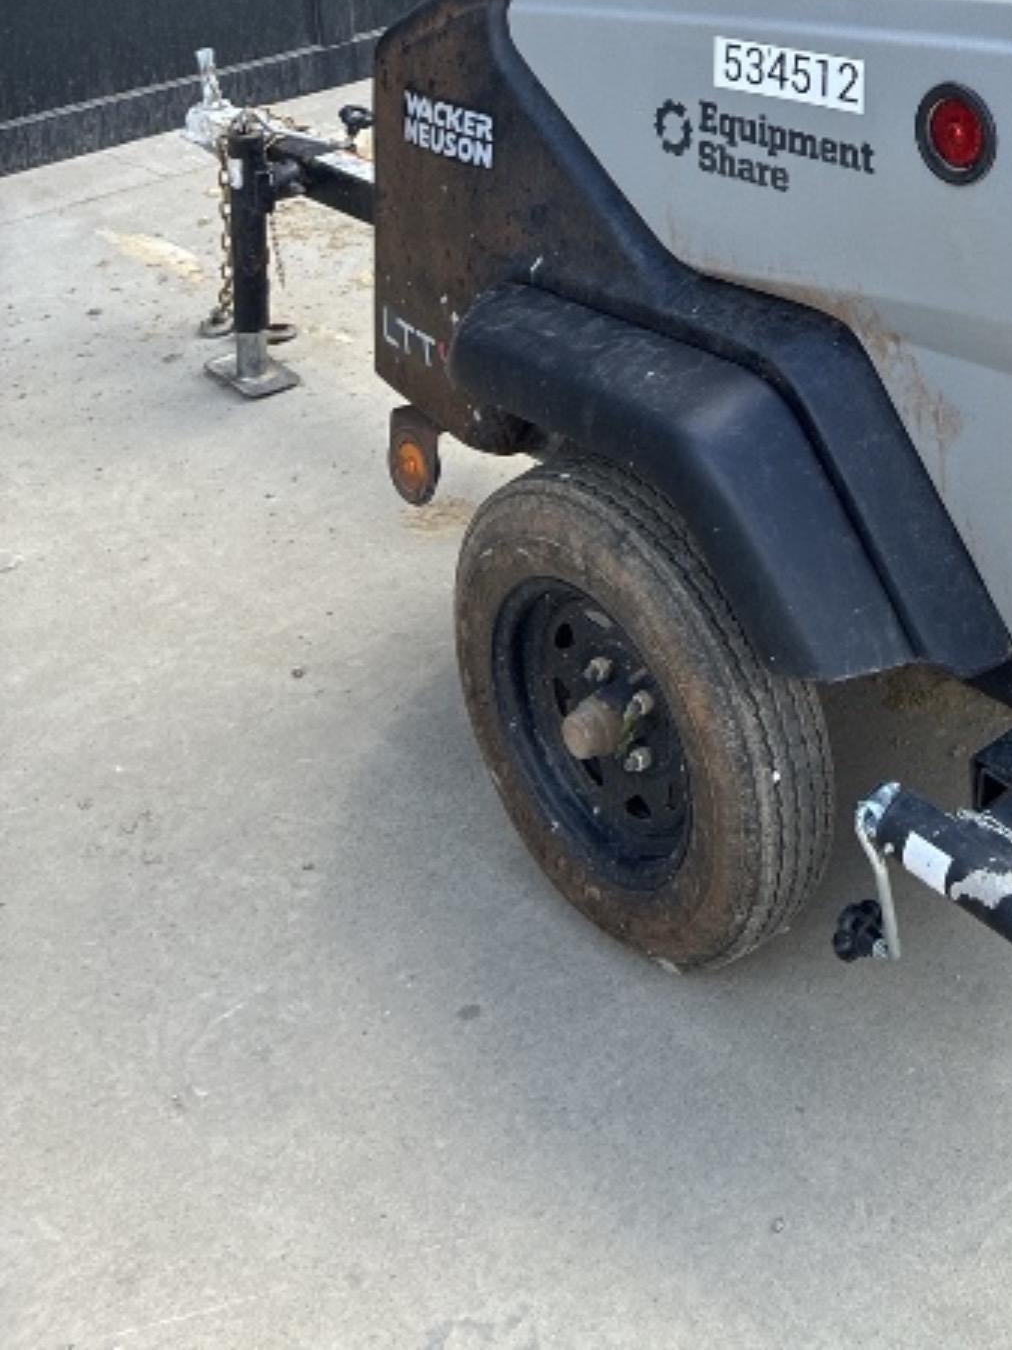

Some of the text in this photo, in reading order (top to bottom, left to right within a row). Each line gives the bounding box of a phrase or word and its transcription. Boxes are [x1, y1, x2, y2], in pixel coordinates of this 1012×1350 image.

[724, 44, 860, 103] 534512
[403, 89, 494, 141] WACKER
[699, 99, 875, 175] Equipment
[403, 116, 493, 169] NEUSON
[699, 140, 790, 193] Share
